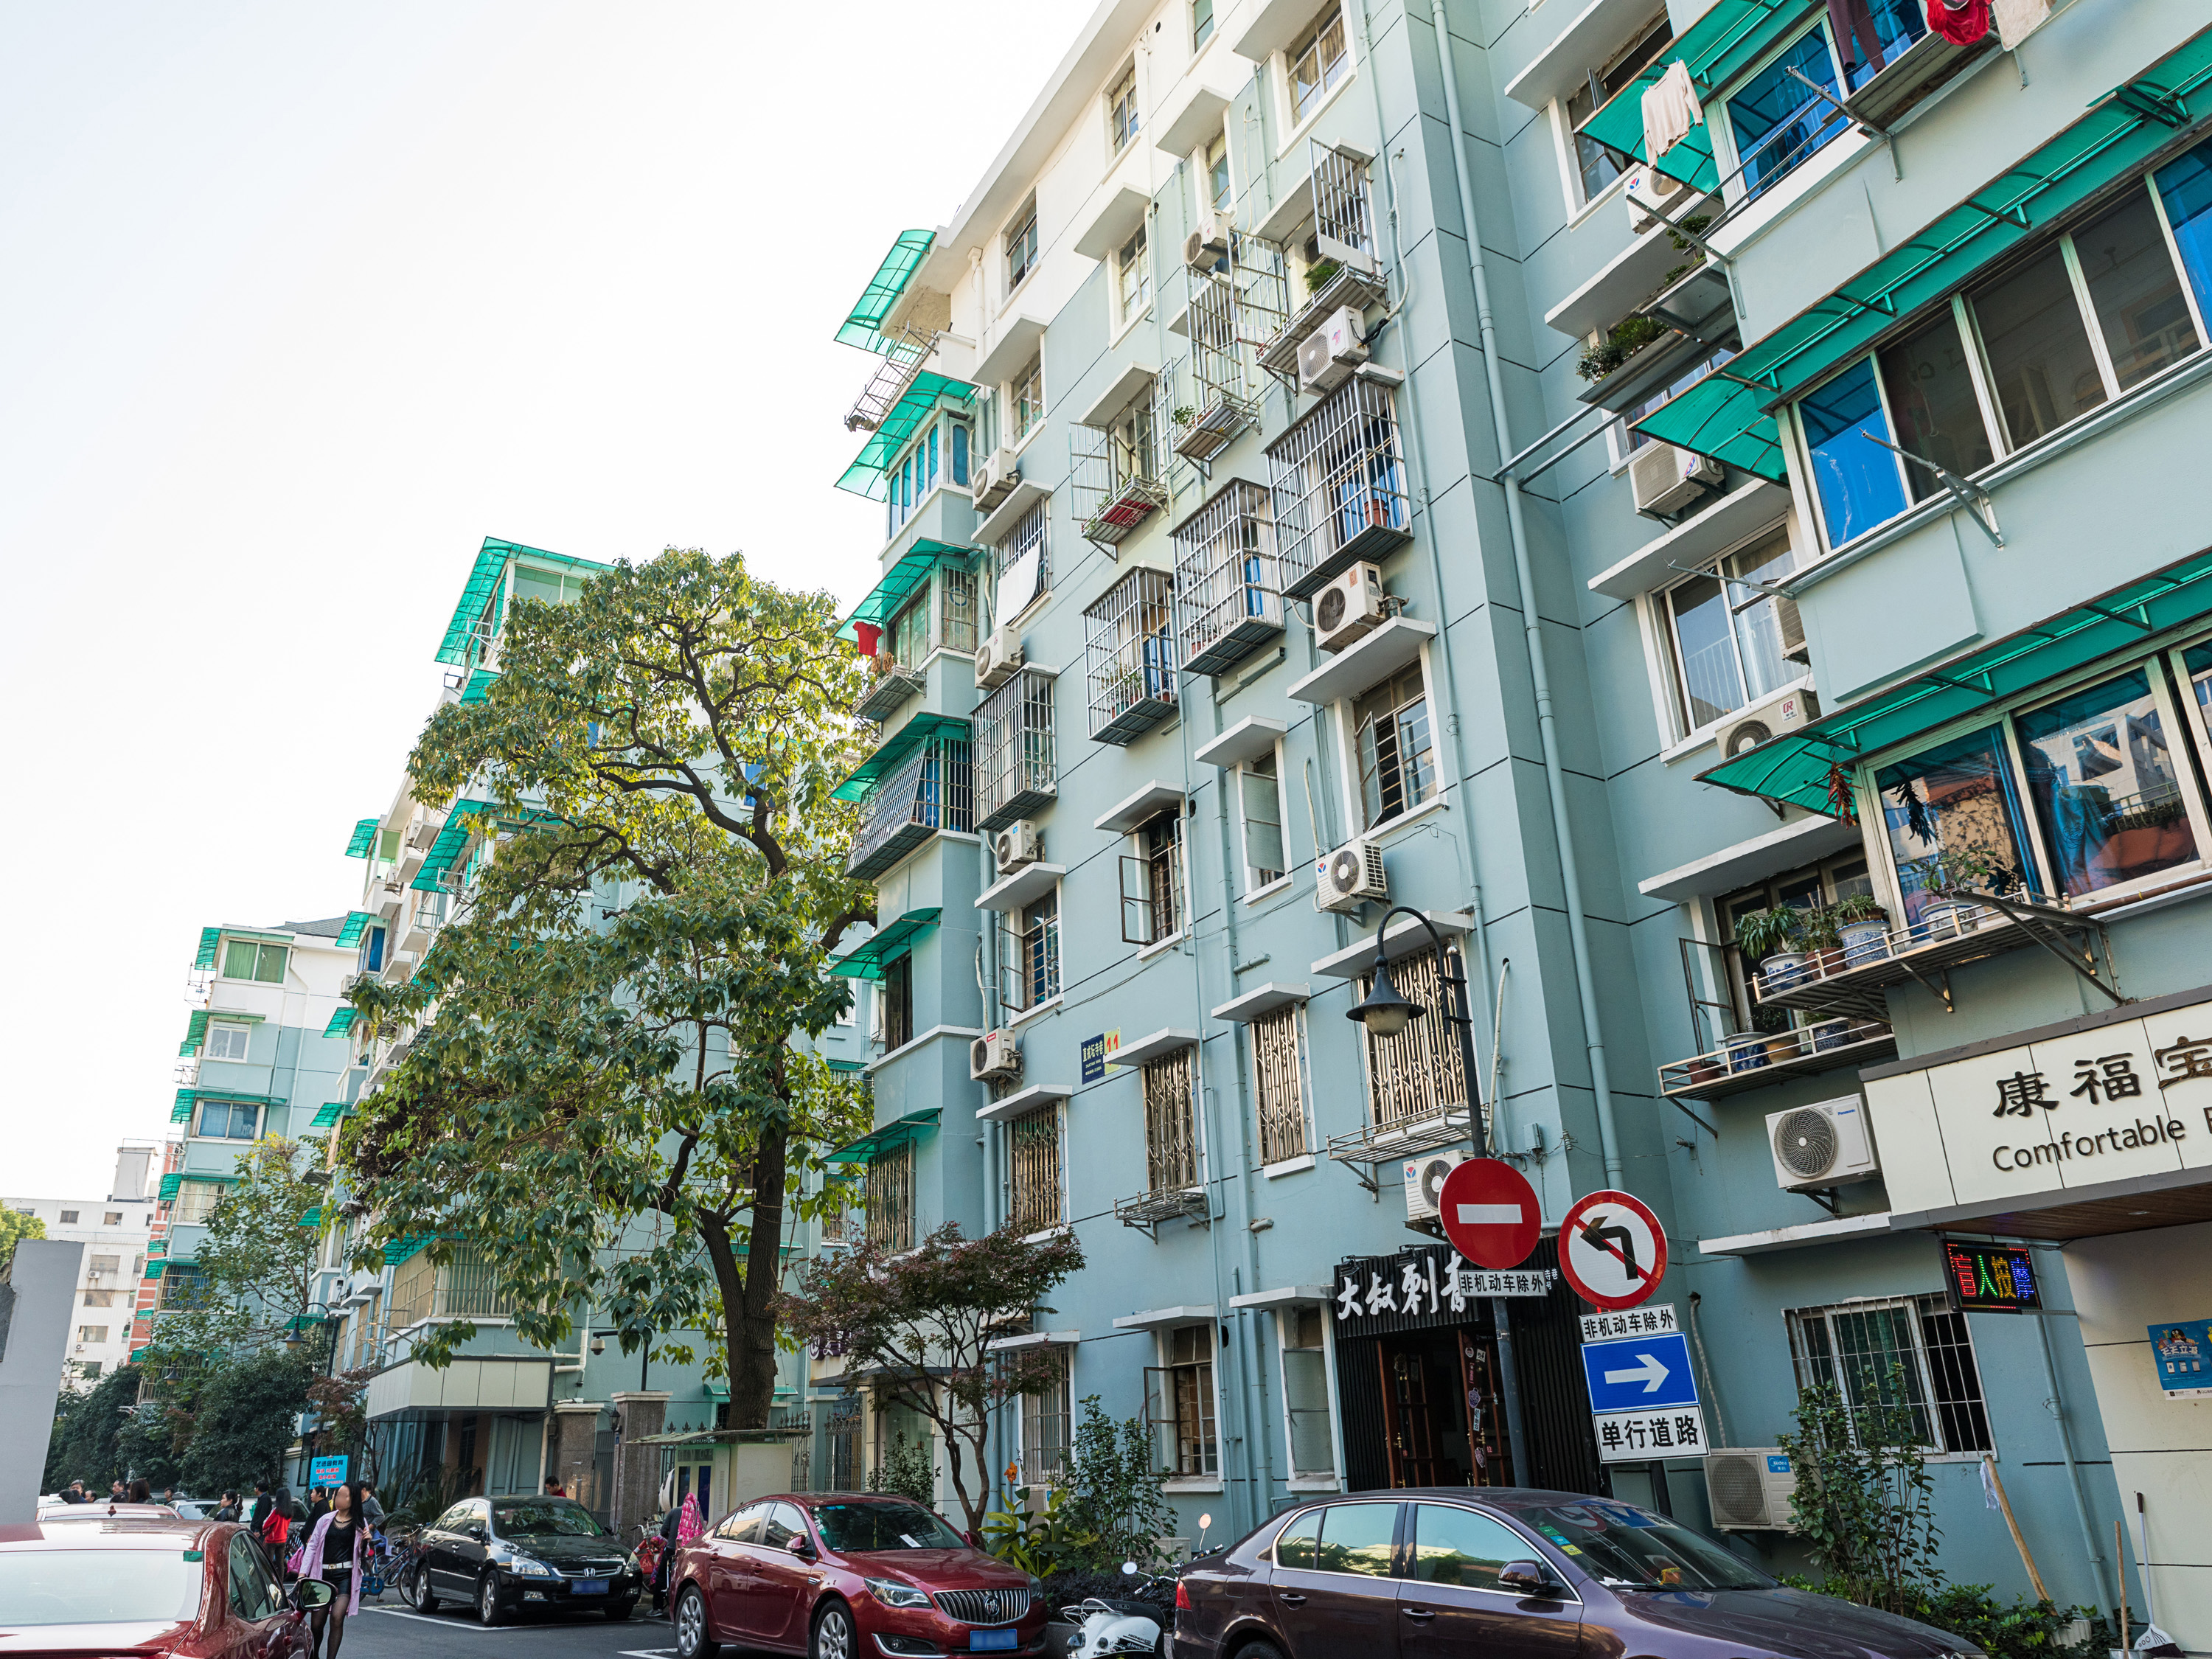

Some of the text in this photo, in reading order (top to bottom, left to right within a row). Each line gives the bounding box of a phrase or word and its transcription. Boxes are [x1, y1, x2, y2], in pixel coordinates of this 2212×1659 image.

[1992, 1036, 2212, 1117] 康福宝
[1992, 1115, 2185, 1171] Comfortable
[1460, 1273, 1544, 1293] 非机动车除外
[1952, 1254, 2034, 1299] 盲人按摩
[1583, 1309, 1674, 1339] 非机动车除外
[1601, 1414, 1699, 1451] 单行道路
